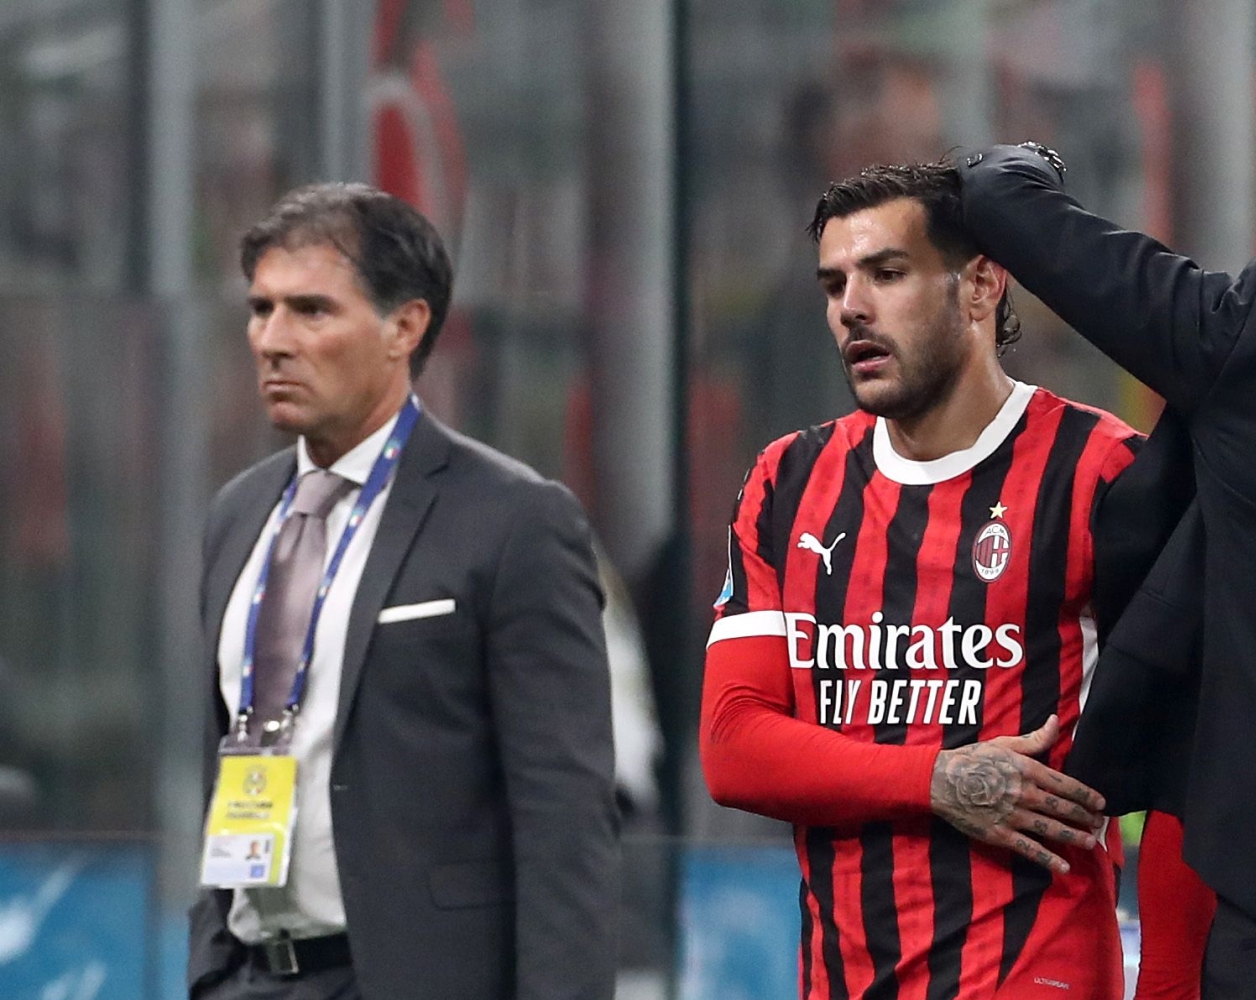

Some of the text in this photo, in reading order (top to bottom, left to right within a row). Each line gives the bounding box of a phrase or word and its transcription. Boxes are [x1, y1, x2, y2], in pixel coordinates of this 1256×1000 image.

[785, 611, 1023, 670] Emirates
[820, 679, 982, 725] FLY BETTER
